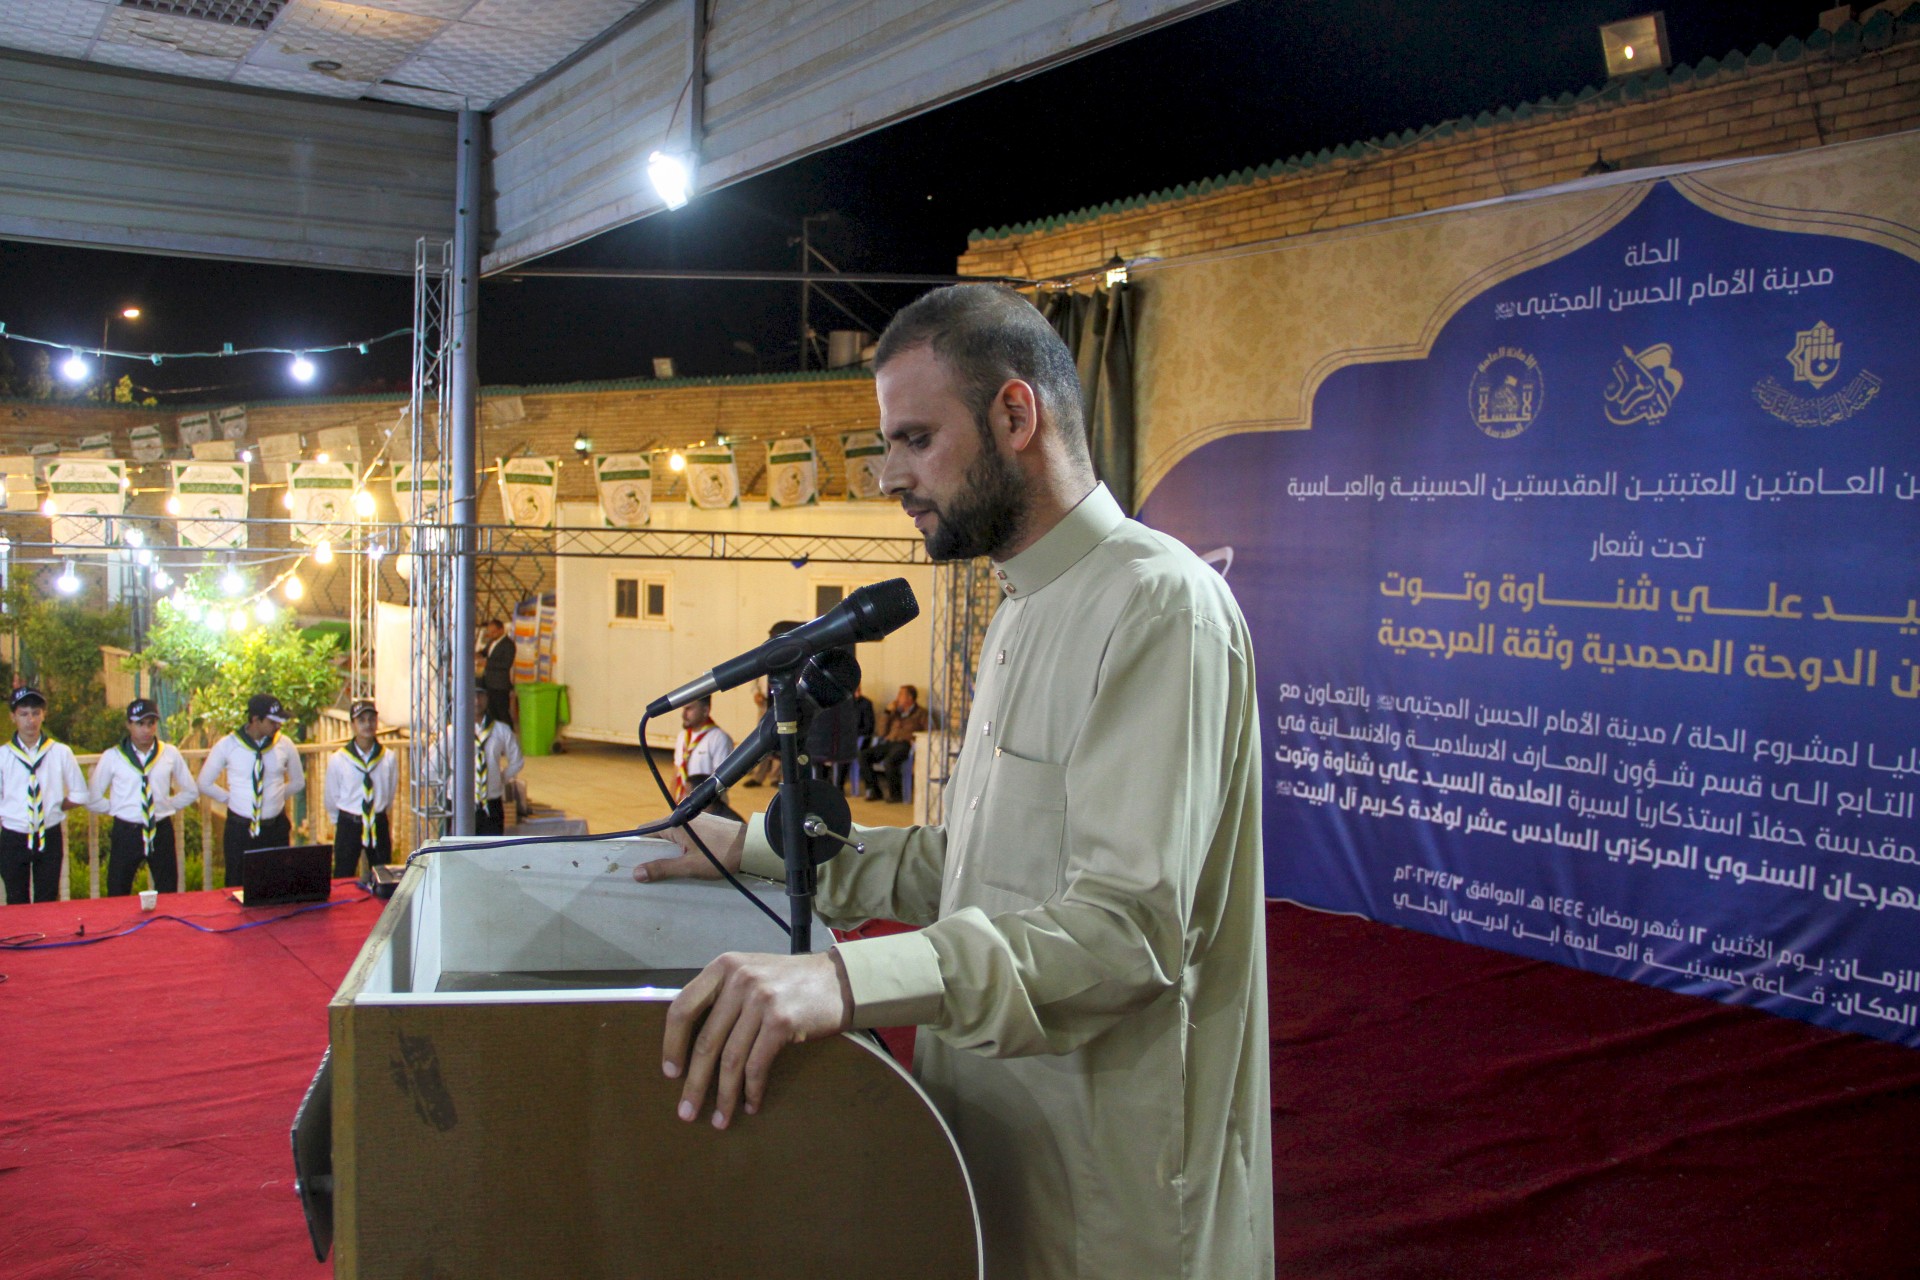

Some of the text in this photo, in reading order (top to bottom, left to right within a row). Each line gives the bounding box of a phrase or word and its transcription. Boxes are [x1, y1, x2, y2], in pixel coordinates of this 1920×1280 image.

[1625, 238, 1679, 266] الحلة
[1609, 277, 1681, 311] الحسن
[1763, 266, 1834, 295] مدينة
[1517, 286, 1601, 319] المجتبى
[1287, 474, 1385, 502] والعباسية
[1390, 473, 1486, 502] الحسينية
[1492, 471, 1617, 502] المقدستين
[1625, 469, 1736, 502] للعتبتين
[1745, 467, 1884, 502] العامتين
[1590, 530, 1706, 561] تحت شعار
[1380, 571, 1490, 611] وتوت
[1498, 573, 1660, 613] شناوة
[1671, 582, 1803, 622] علي
[1378, 618, 1495, 660] المرجعية
[1503, 624, 1573, 670] وثقة
[1582, 633, 1733, 675] المحمدية
[1744, 644, 1877, 691] الدوحة
[1279, 683, 1301, 702] مع
[1304, 682, 1370, 712] بالتعاون
[1278, 713, 1306, 734] في
[1395, 695, 1470, 722] المجتبى
[1475, 704, 1538, 728] الحسن
[1309, 716, 1402, 751] والانسانية
[1405, 729, 1506, 762] الاسلامية
[1607, 717, 1667, 747] مدينة
[1688, 725, 1746, 754] الحلة
[1275, 745, 1319, 773] وتوت
[1323, 750, 1374, 776] شناوة
[1513, 745, 1607, 776] المعارف
[1753, 734, 1858, 767] لمشروع
[1378, 760, 1419, 785] علي
[1422, 771, 1485, 796] السيد
[1613, 759, 1695, 789] شؤون
[1701, 774, 1763, 798] قسم
[1293, 780, 1336, 806] البيت
[1359, 794, 1405, 818] كريم
[1489, 775, 1563, 808] العلامة
[1567, 789, 1629, 820] لسيرة
[1837, 787, 1914, 819] التابع
[1408, 798, 1462, 831] لولادة
[1464, 807, 1507, 836] عشر
[1512, 822, 1599, 852] السادس
[1815, 826, 1920, 865] مقدسة
[1605, 834, 1698, 871] المركزي
[1704, 854, 1816, 891] السنوي
[1393, 891, 1448, 916] الحلي
[1466, 880, 1525, 907] الموافق
[1823, 872, 1920, 911] هرجان
[1451, 907, 1509, 932] ادريس
[1549, 896, 1584, 919] ١٤٤٤
[1587, 906, 1639, 935] رمضان
[1512, 919, 1560, 946] ابن
[1642, 919, 1684, 941] شهر
[1689, 925, 1707, 945] ١٢
[1563, 930, 1639, 961] العلامة
[1712, 933, 1773, 960] الاثنين
[1643, 948, 1747, 987] حسينية
[1776, 949, 1824, 976] يوم
[1752, 971, 1825, 1005] قاعة
